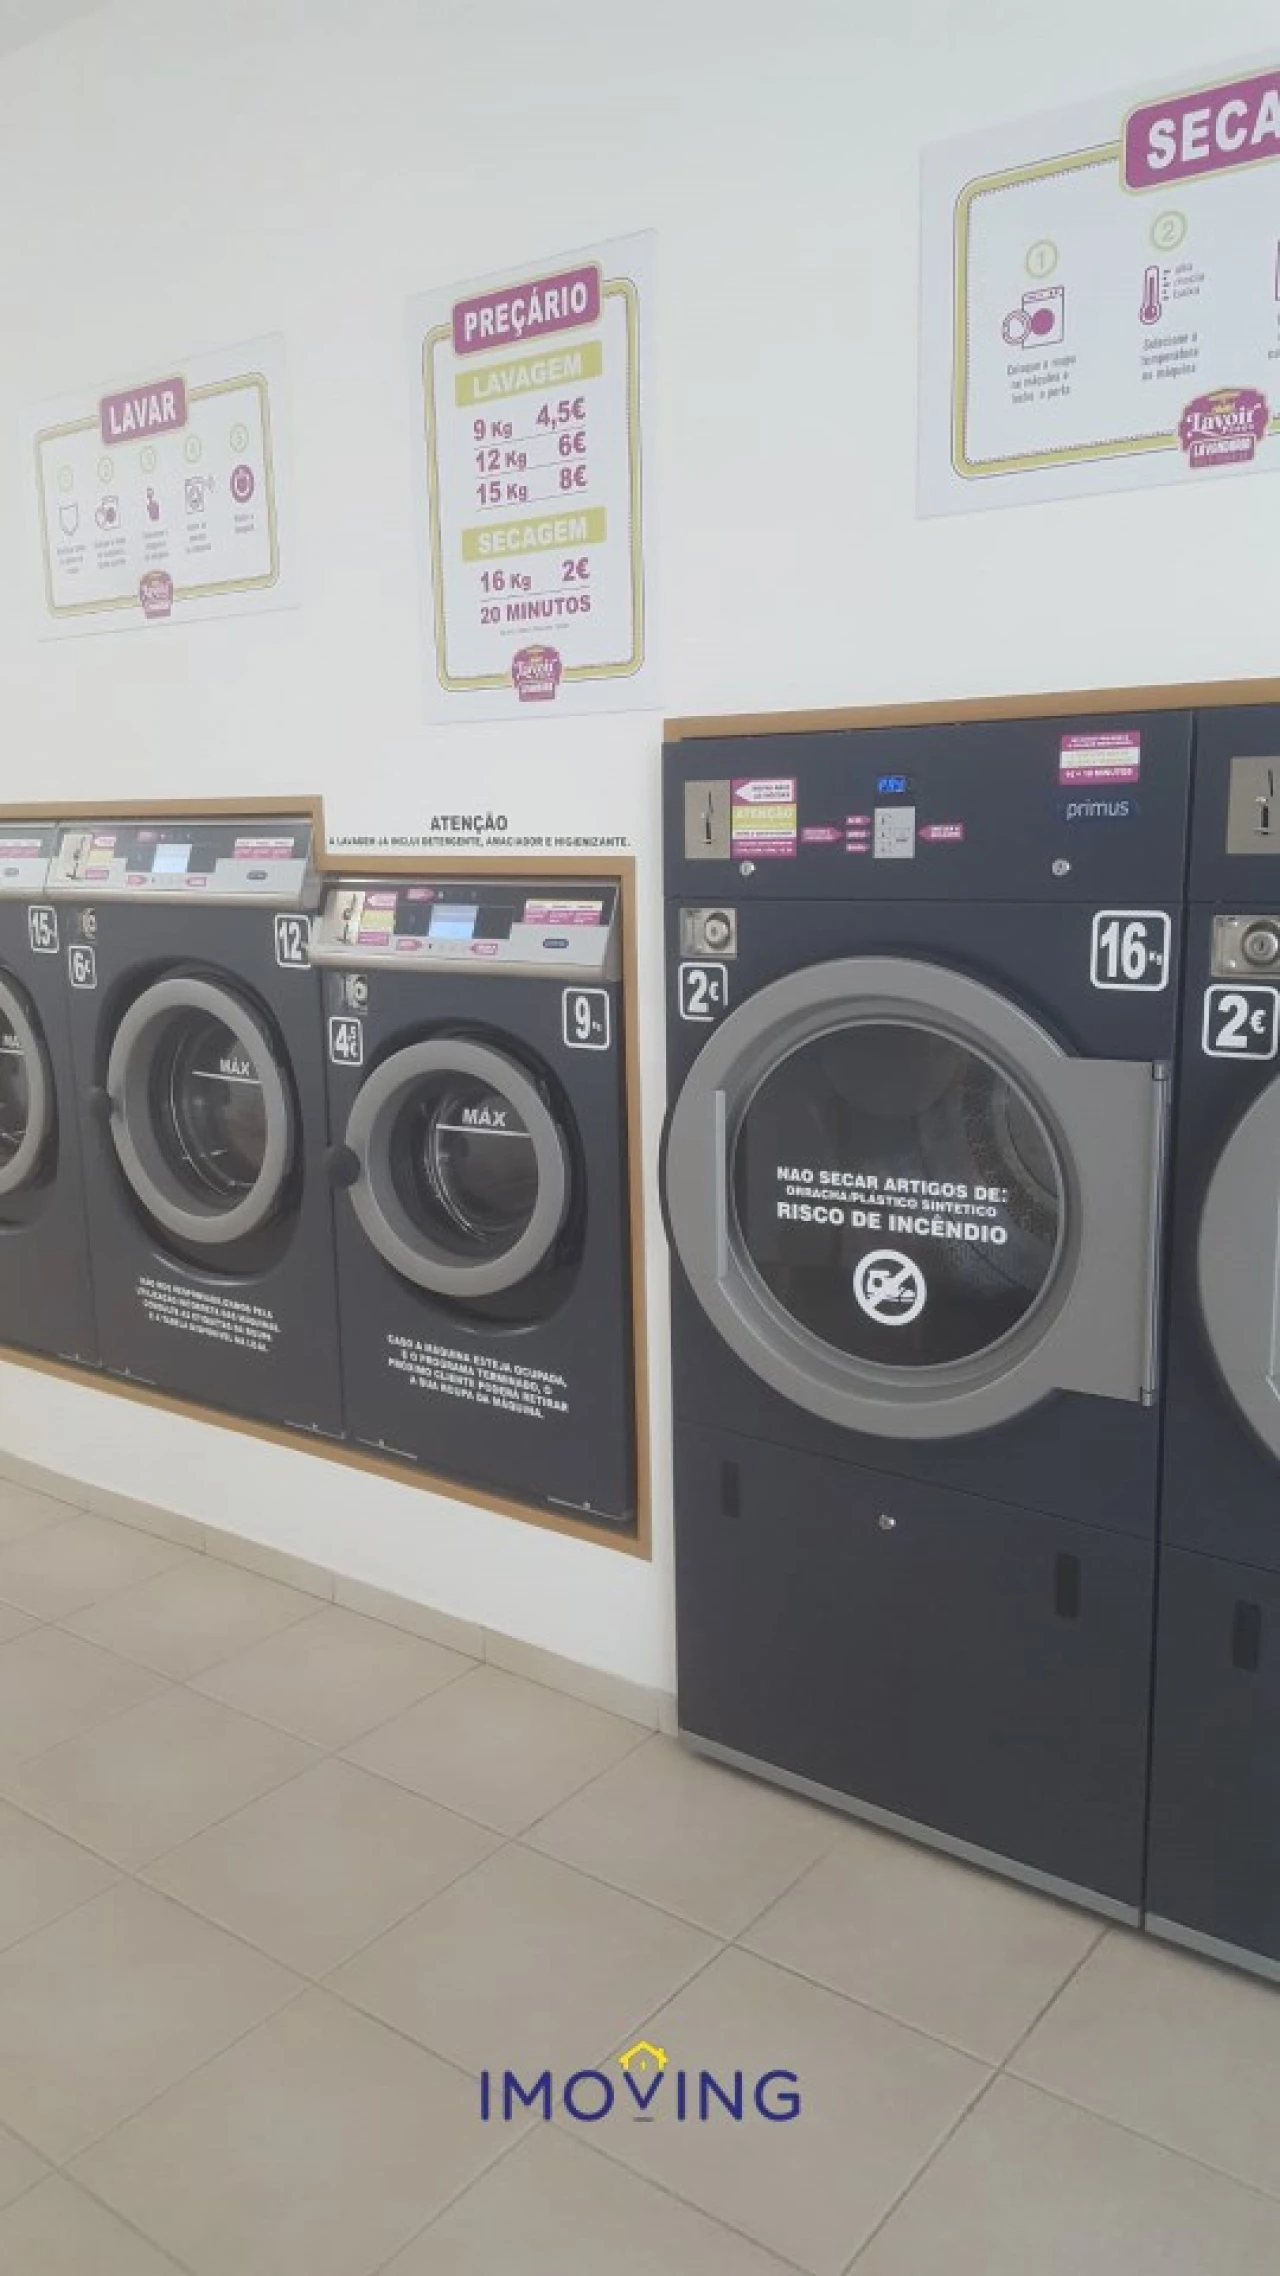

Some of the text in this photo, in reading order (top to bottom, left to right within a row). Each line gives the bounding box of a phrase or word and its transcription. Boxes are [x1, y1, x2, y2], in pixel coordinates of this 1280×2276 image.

[464, 281, 588, 342] PREÇÁRIO
[473, 352, 582, 399] LAVAGEM
[108, 390, 176, 435] LAVAR
[473, 418, 487, 441] 9
[536, 396, 586, 430] 4,5€
[476, 448, 501, 472] 12
[558, 431, 587, 457] 6€
[476, 481, 501, 505] 15
[559, 464, 588, 491] 8€
[478, 516, 588, 554] SECAGEM
[480, 569, 505, 593] 16
[561, 557, 590, 582] 2€
[480, 594, 591, 625] 20 MINUTOS
[430, 812, 508, 835] ATENÇÃO
[1066, 799, 1129, 821] primus
[32, 912, 51, 946] 15
[279, 921, 302, 961] 12
[1101, 921, 1147, 980] 16
[687, 970, 718, 1013] 2€
[575, 995, 591, 1040] 9
[1215, 993, 1267, 1049] 2€
[219, 1057, 250, 1076] MÁX
[462, 1107, 506, 1127] MÁX
[819, 1170, 878, 1191] SECAR
[883, 1176, 968, 1198] ARTIGOS
[973, 1185, 1008, 1204] DE:
[777, 1201, 1009, 1245] RISCO DE INCÊNDIO
